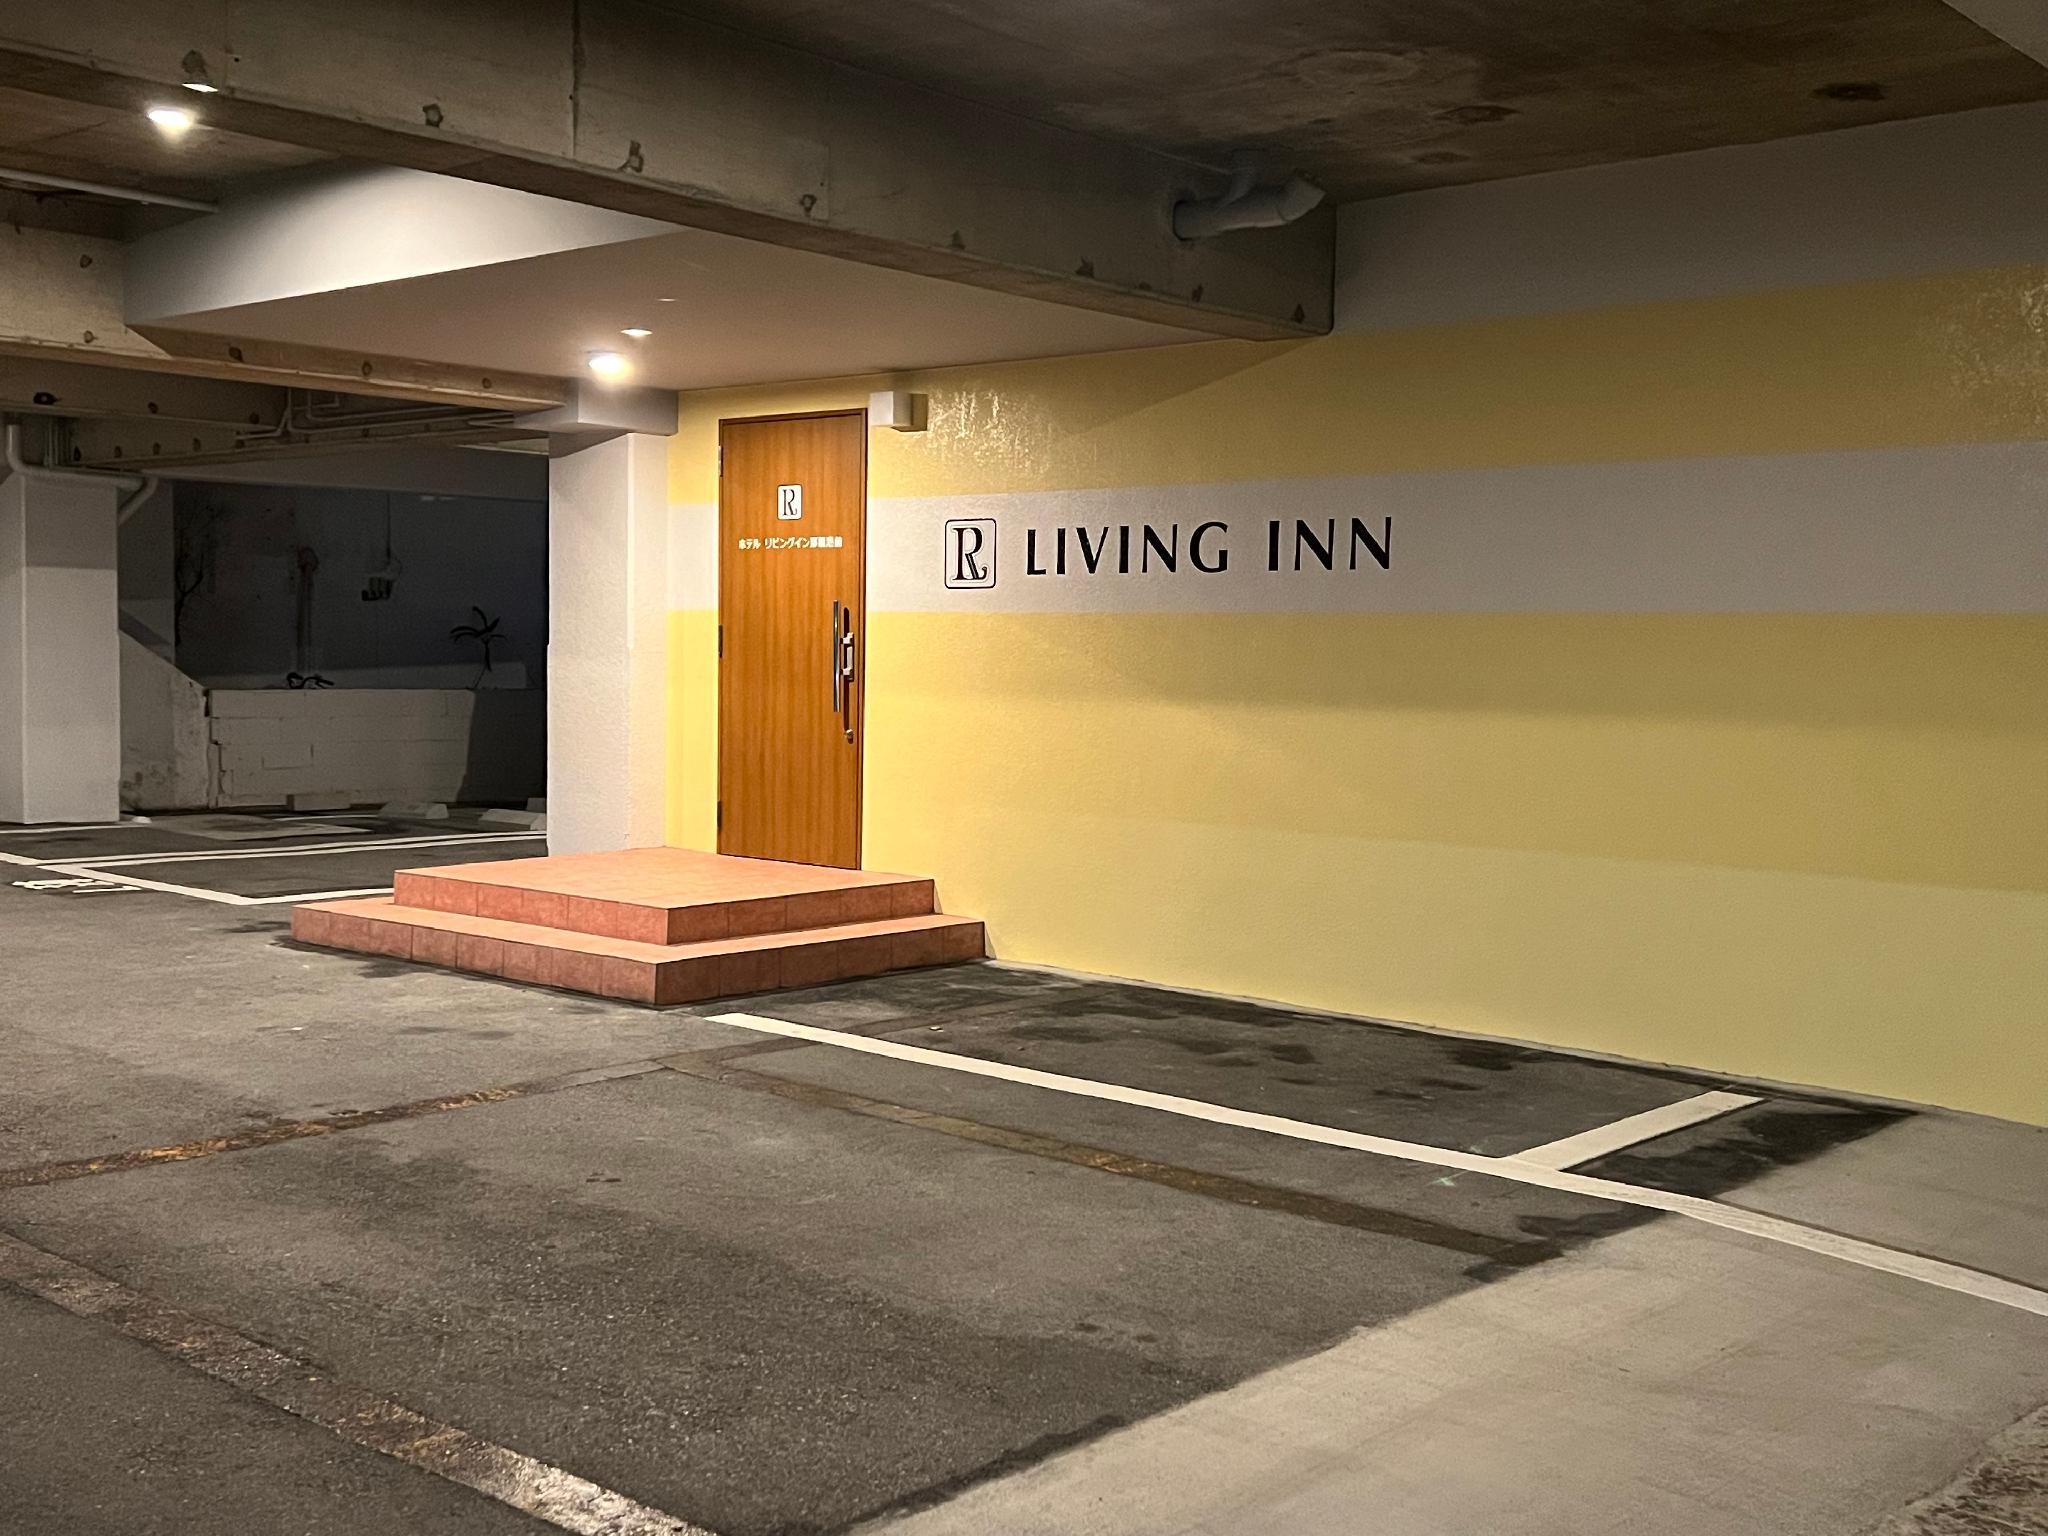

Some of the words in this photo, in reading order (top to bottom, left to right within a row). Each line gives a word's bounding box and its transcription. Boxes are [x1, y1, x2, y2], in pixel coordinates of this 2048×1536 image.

[738, 538, 761, 550] ホテル
[952, 527, 988, 581] R
[1027, 521, 1229, 575] LIVING
[1268, 517, 1392, 572] INN
